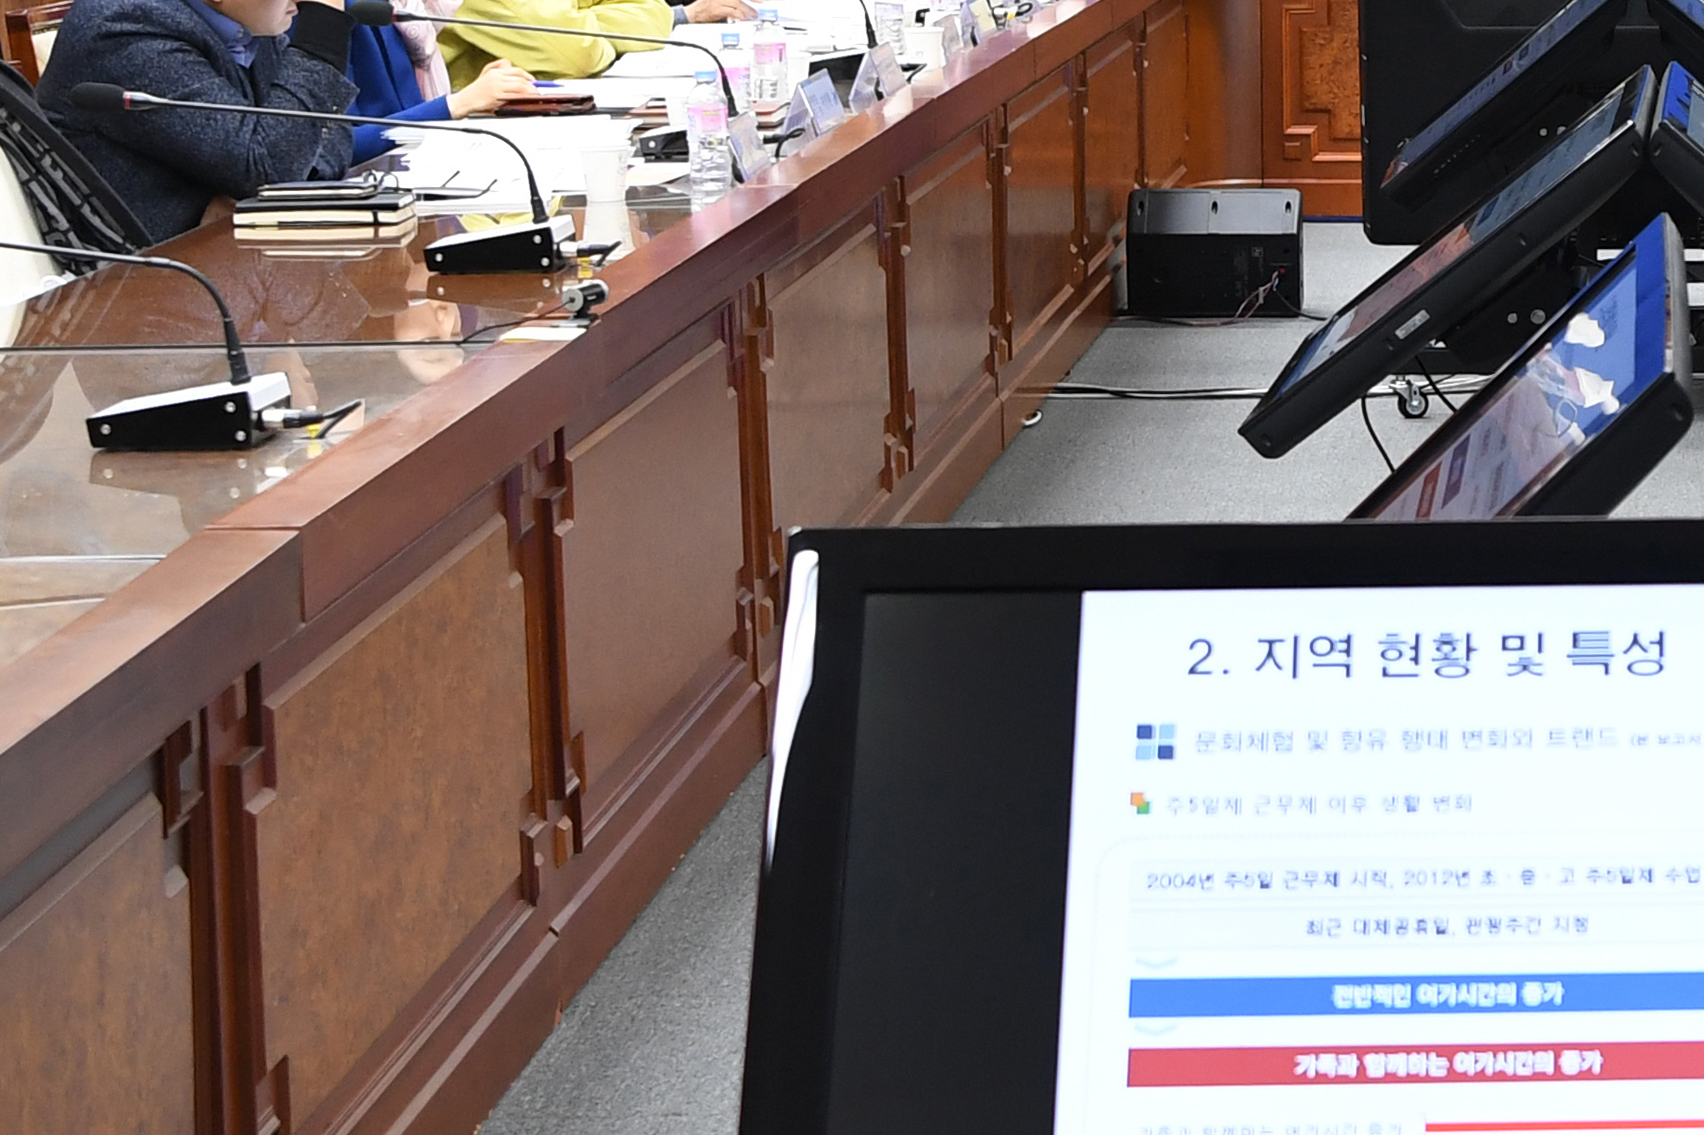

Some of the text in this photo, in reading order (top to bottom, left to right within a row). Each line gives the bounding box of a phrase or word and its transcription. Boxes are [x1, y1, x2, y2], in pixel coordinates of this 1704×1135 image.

[1188, 630, 1665, 679] 2. 지역 현황 및 특성
[1195, 731, 1294, 754] 문화체험
[1328, 795, 1367, 814] 이후
[1432, 794, 1472, 812] 변화
[1147, 874, 1214, 891] 2004년
[1293, 1053, 1360, 1079] 가족과
[1362, 1052, 1450, 1078] 함께하는
[1452, 1051, 1555, 1077] 여가시간의
